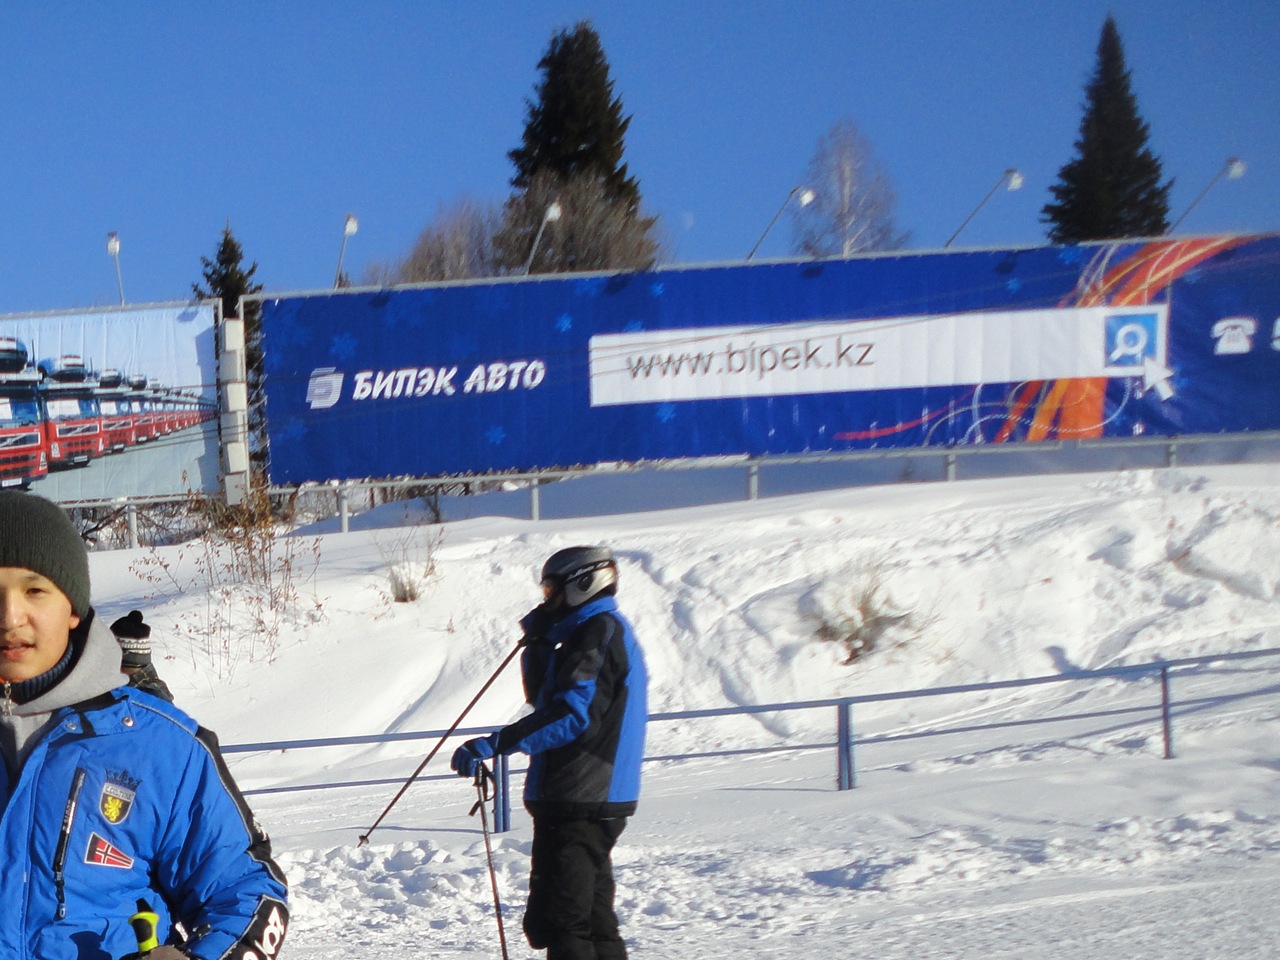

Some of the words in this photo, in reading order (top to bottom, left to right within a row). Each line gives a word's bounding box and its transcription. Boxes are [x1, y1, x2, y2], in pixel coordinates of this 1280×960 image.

[626, 335, 877, 380] www.bipek.kz
[352, 366, 458, 400] БИПЭК
[463, 359, 546, 394] АВТО
